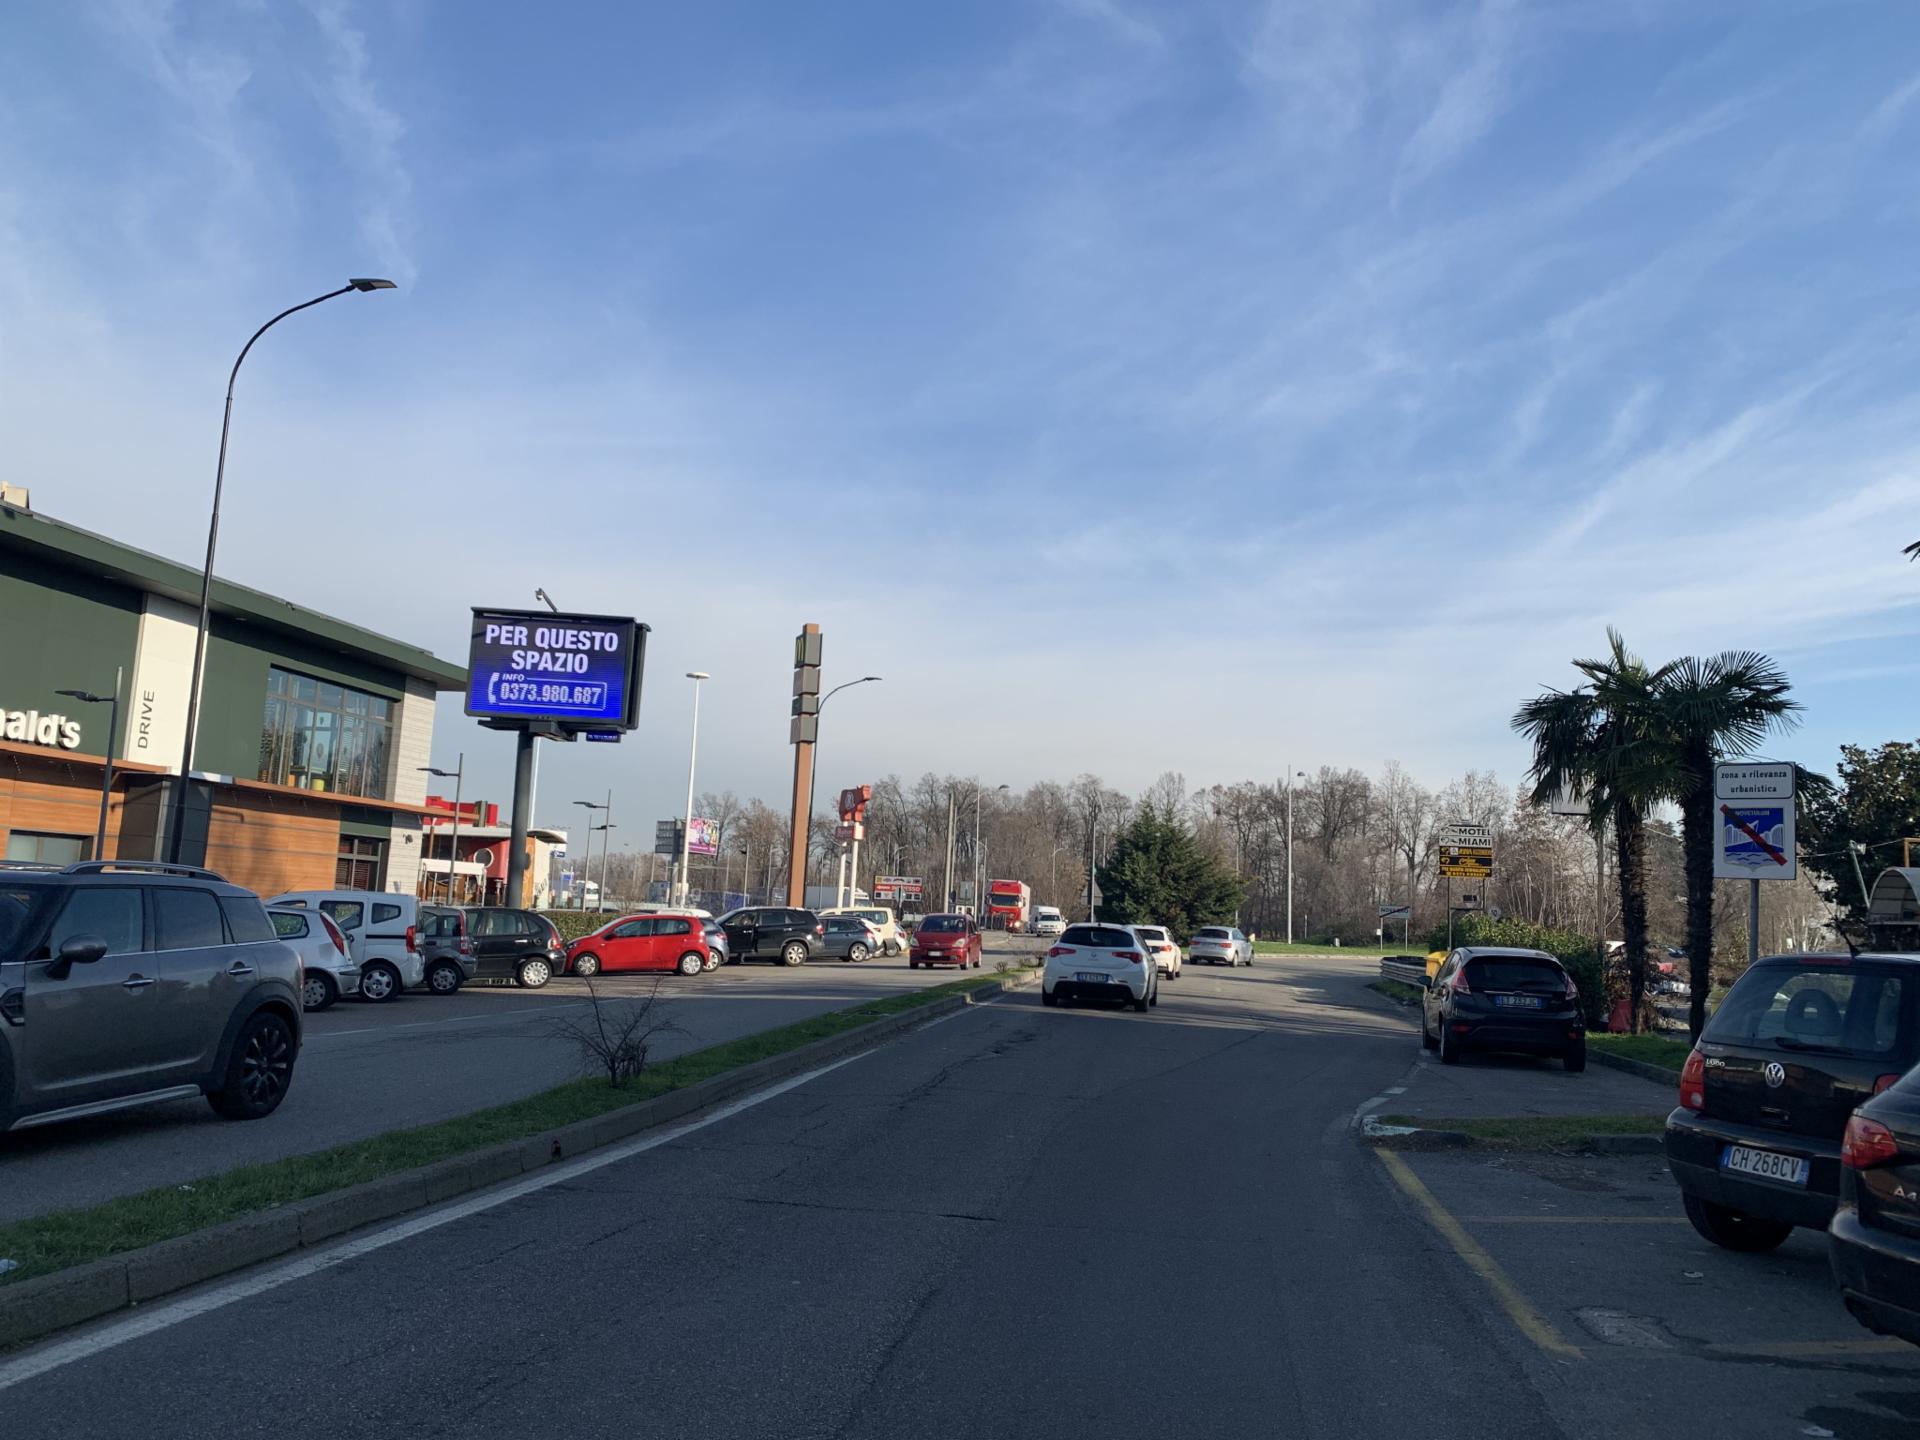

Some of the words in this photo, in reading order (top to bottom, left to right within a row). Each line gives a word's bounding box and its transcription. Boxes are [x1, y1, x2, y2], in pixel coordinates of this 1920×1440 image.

[485, 624, 528, 646] PER
[534, 627, 619, 652] QUESTO
[511, 650, 589, 674] SPAZIO
[502, 673, 525, 682] INFO
[500, 682, 602, 705] 0373.980.687
[137, 690, 155, 749] DRIVE
[1749, 770, 1787, 778] rilevanza
[1730, 784, 1777, 793] urbanistica
[1458, 828, 1492, 836] MOTEL
[1458, 837, 1491, 846] MIAMI
[1731, 1148, 1751, 1169] CH
[1894, 1185, 1917, 1200] A4
